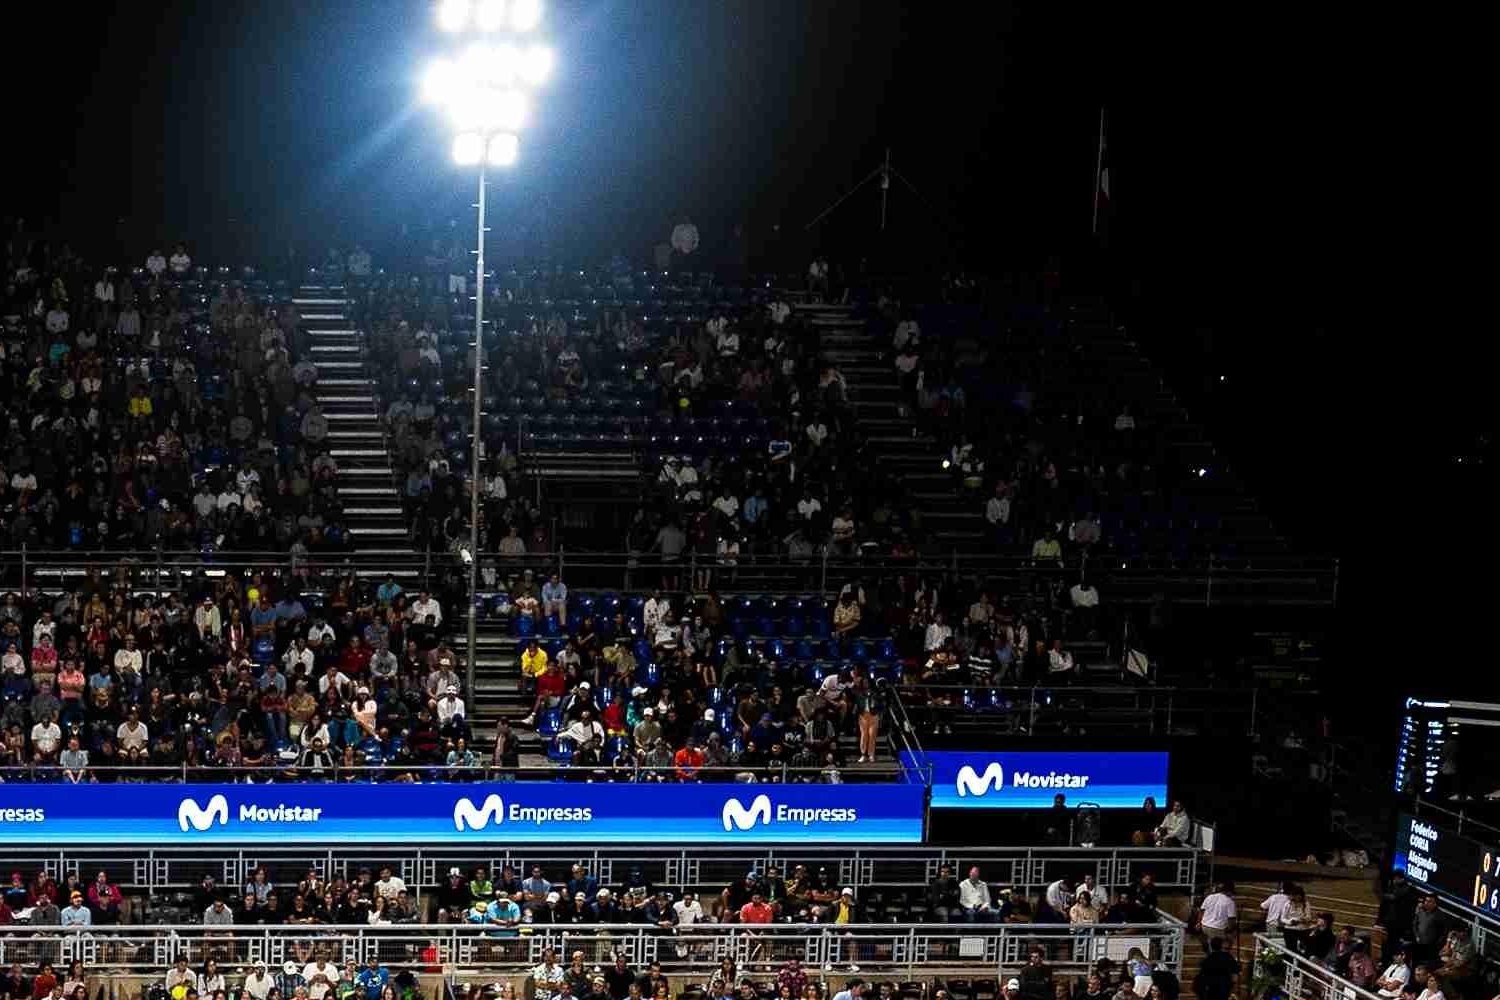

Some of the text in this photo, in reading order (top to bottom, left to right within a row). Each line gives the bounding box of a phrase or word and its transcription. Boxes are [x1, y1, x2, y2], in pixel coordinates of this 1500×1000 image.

[1013, 772, 1088, 788] Movistar
[239, 804, 321, 821] Movistar
[509, 804, 591, 824] Empresas
[777, 804, 856, 825] Empresas
[1484, 852, 1490, 873] 0
[1480, 884, 1498, 909] 0 6
